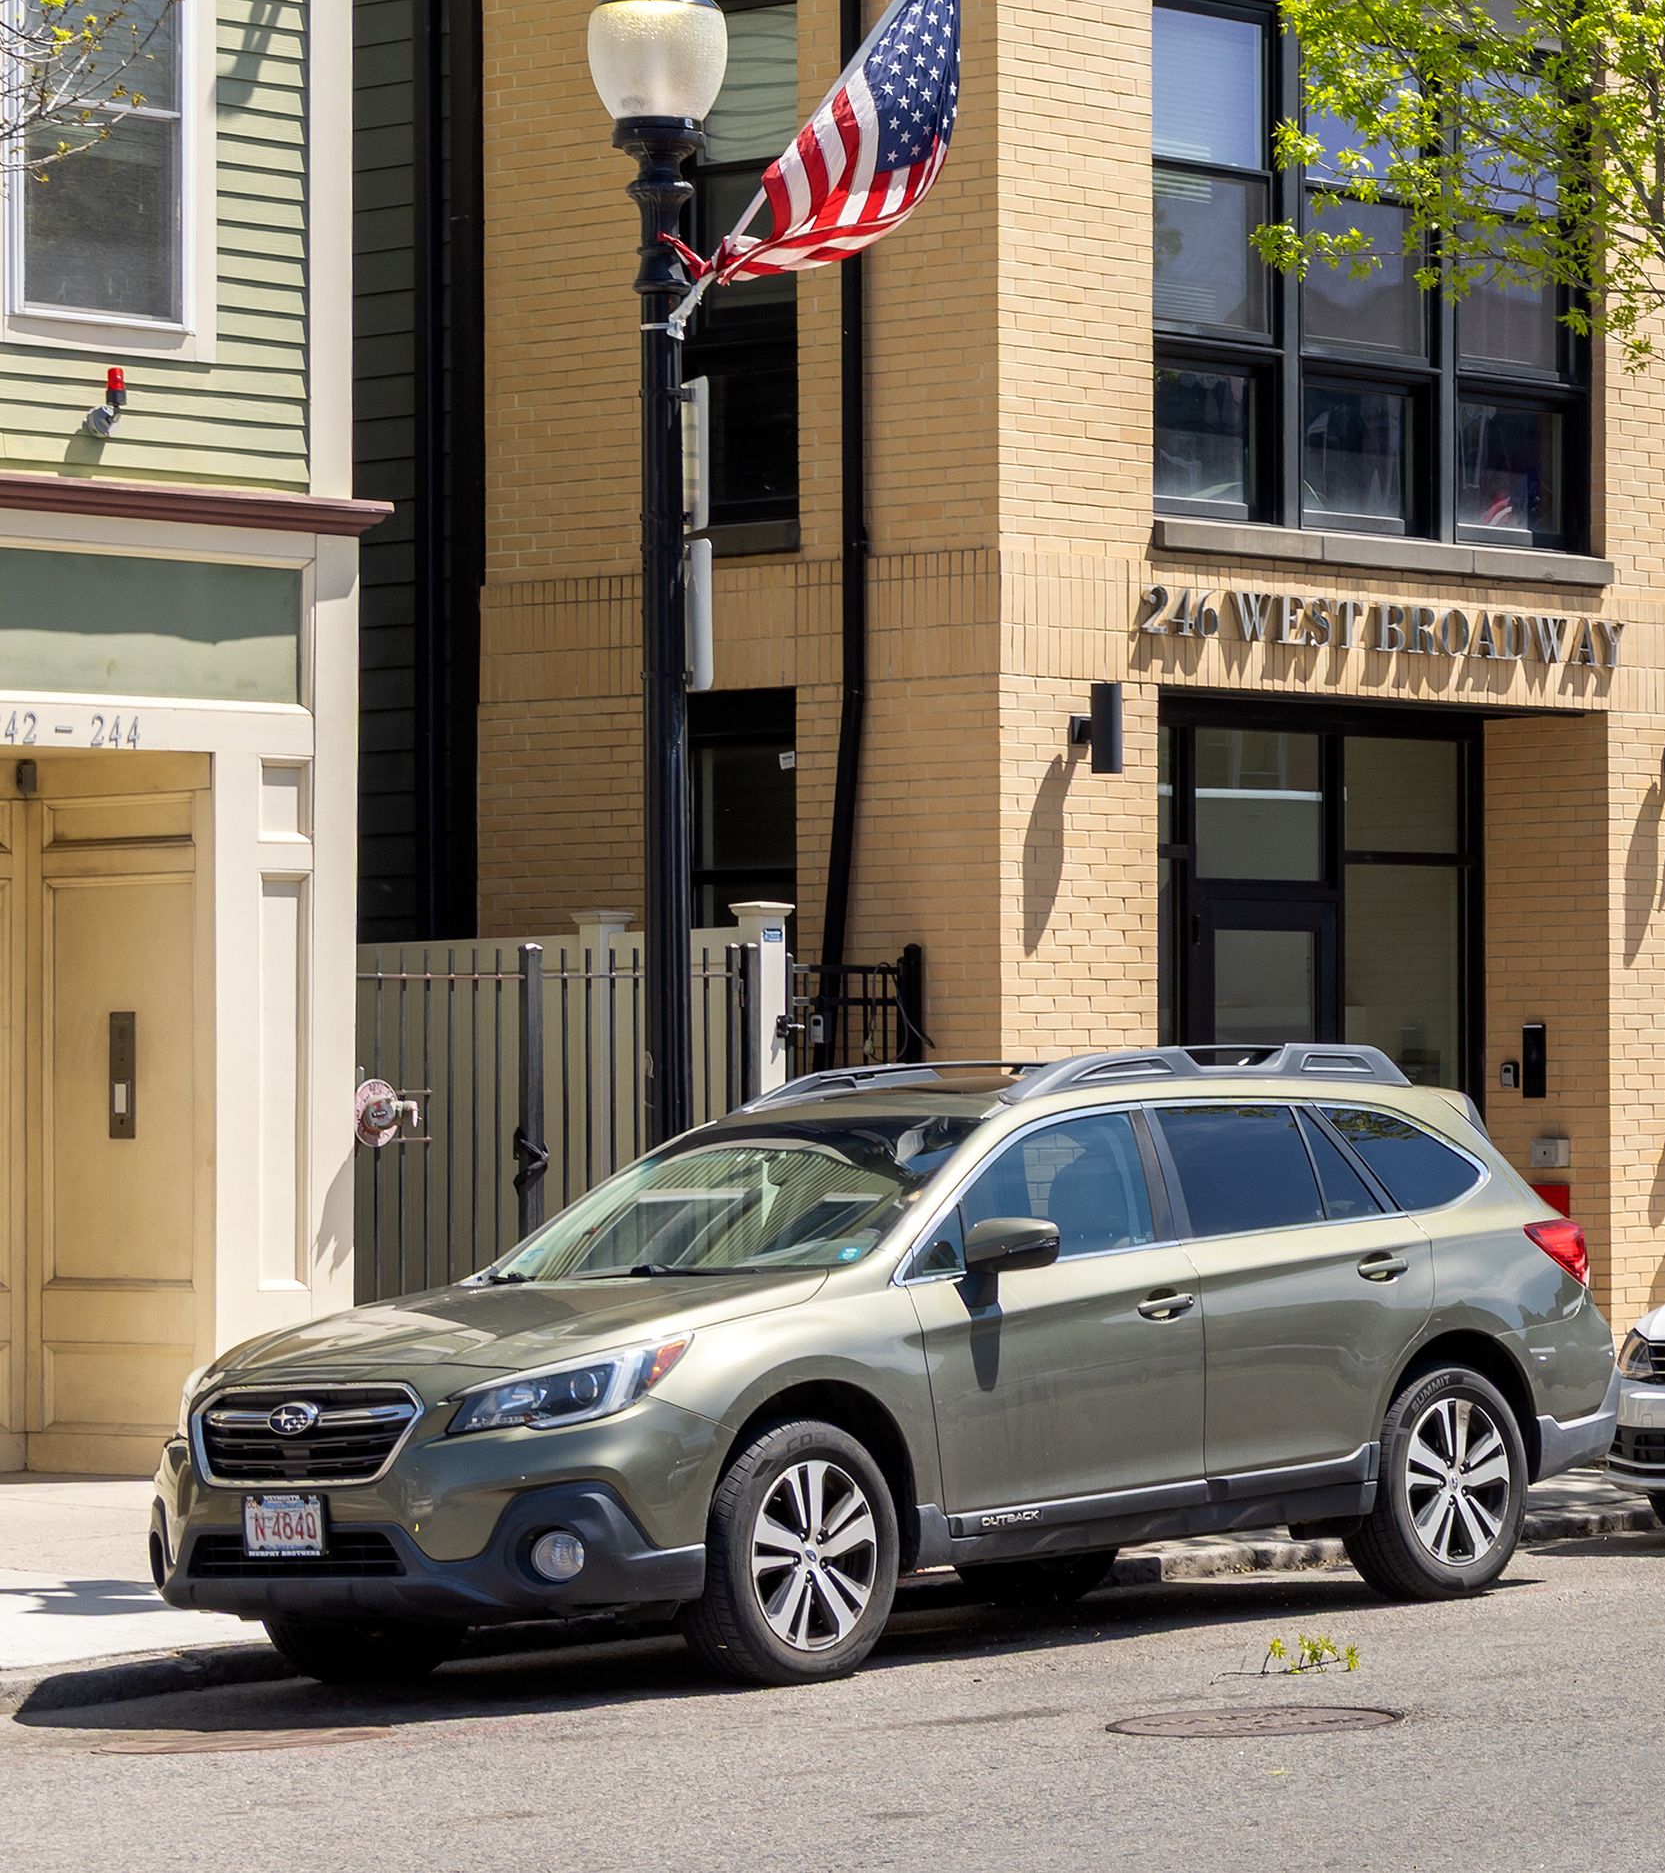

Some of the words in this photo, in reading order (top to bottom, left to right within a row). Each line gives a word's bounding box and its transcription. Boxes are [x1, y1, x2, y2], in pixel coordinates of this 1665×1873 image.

[1141, 585, 1219, 640] 246
[1231, 590, 1364, 650] WEST
[1371, 603, 1626, 667] BROADWAY
[90, 712, 140, 750] 244
[1411, 1374, 1450, 1413] SUMMIT
